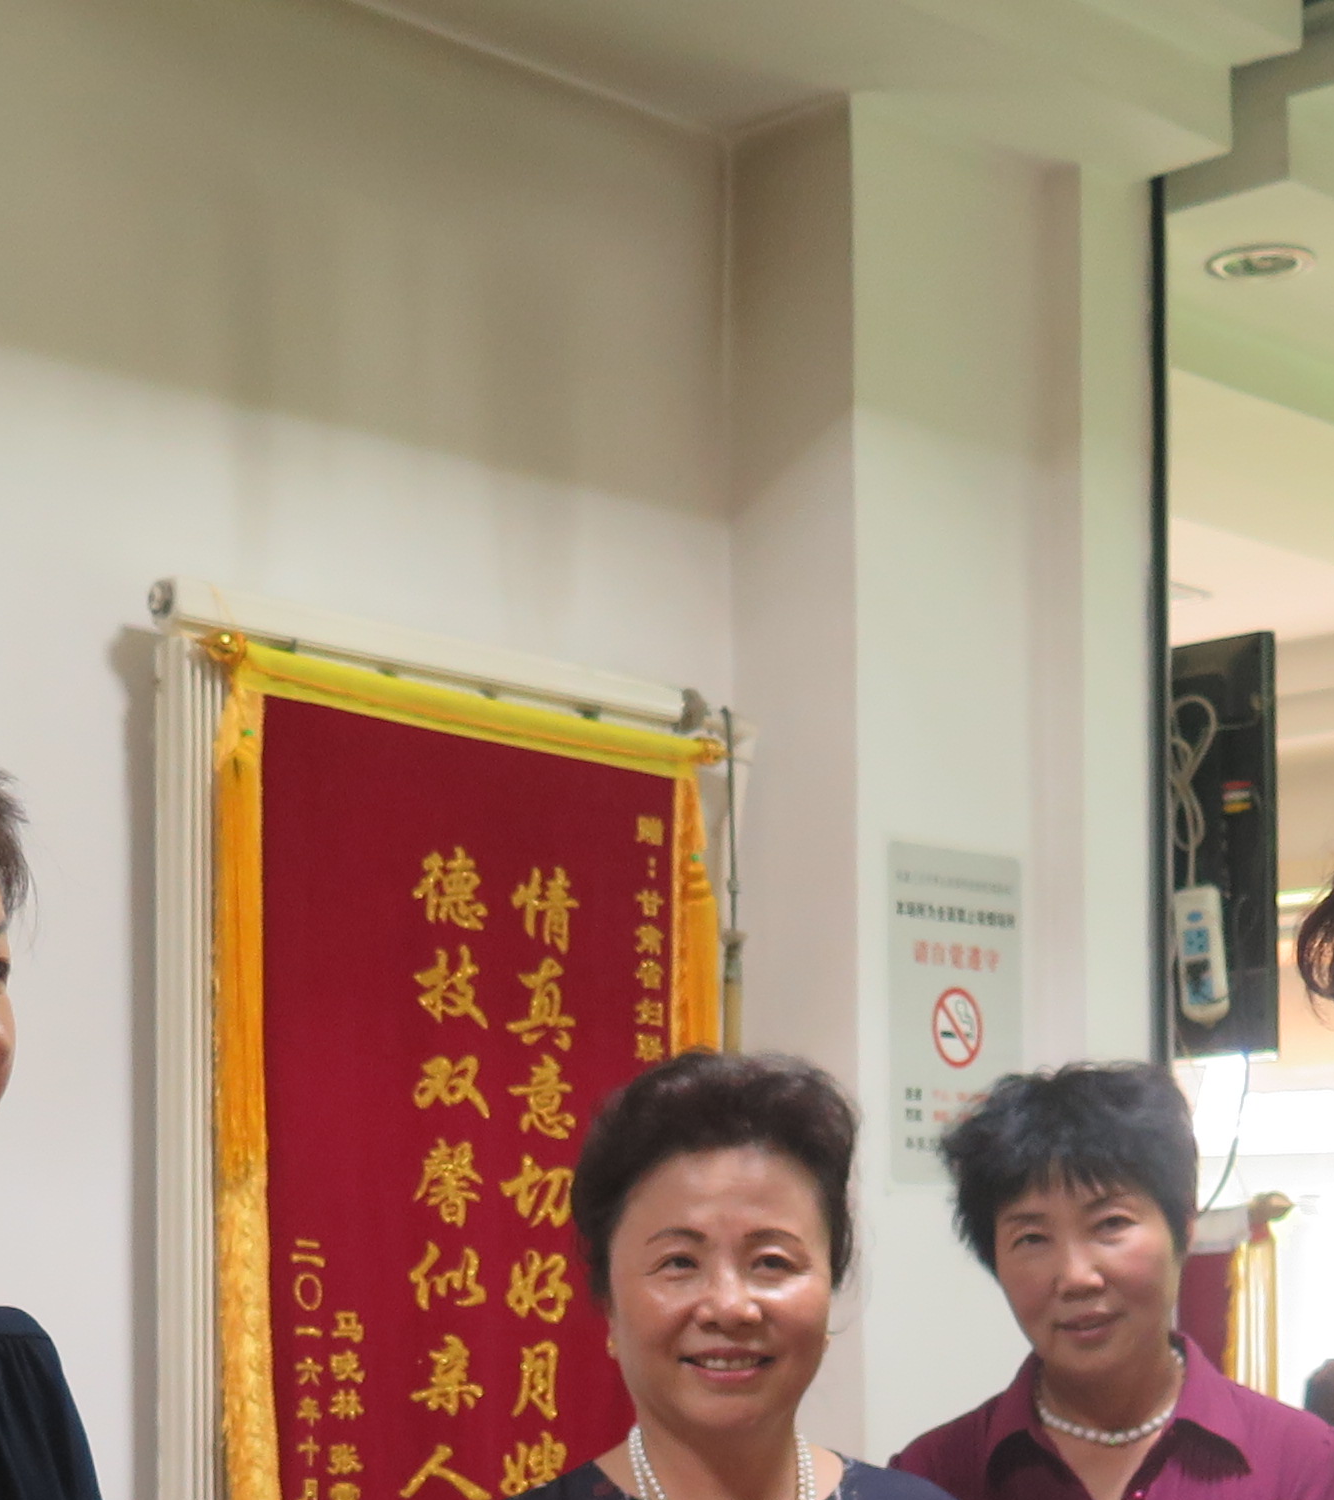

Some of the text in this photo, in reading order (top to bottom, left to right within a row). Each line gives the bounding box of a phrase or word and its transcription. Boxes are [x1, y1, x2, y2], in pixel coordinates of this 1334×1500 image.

[499, 865, 579, 1496] 情真意切好月嫂
